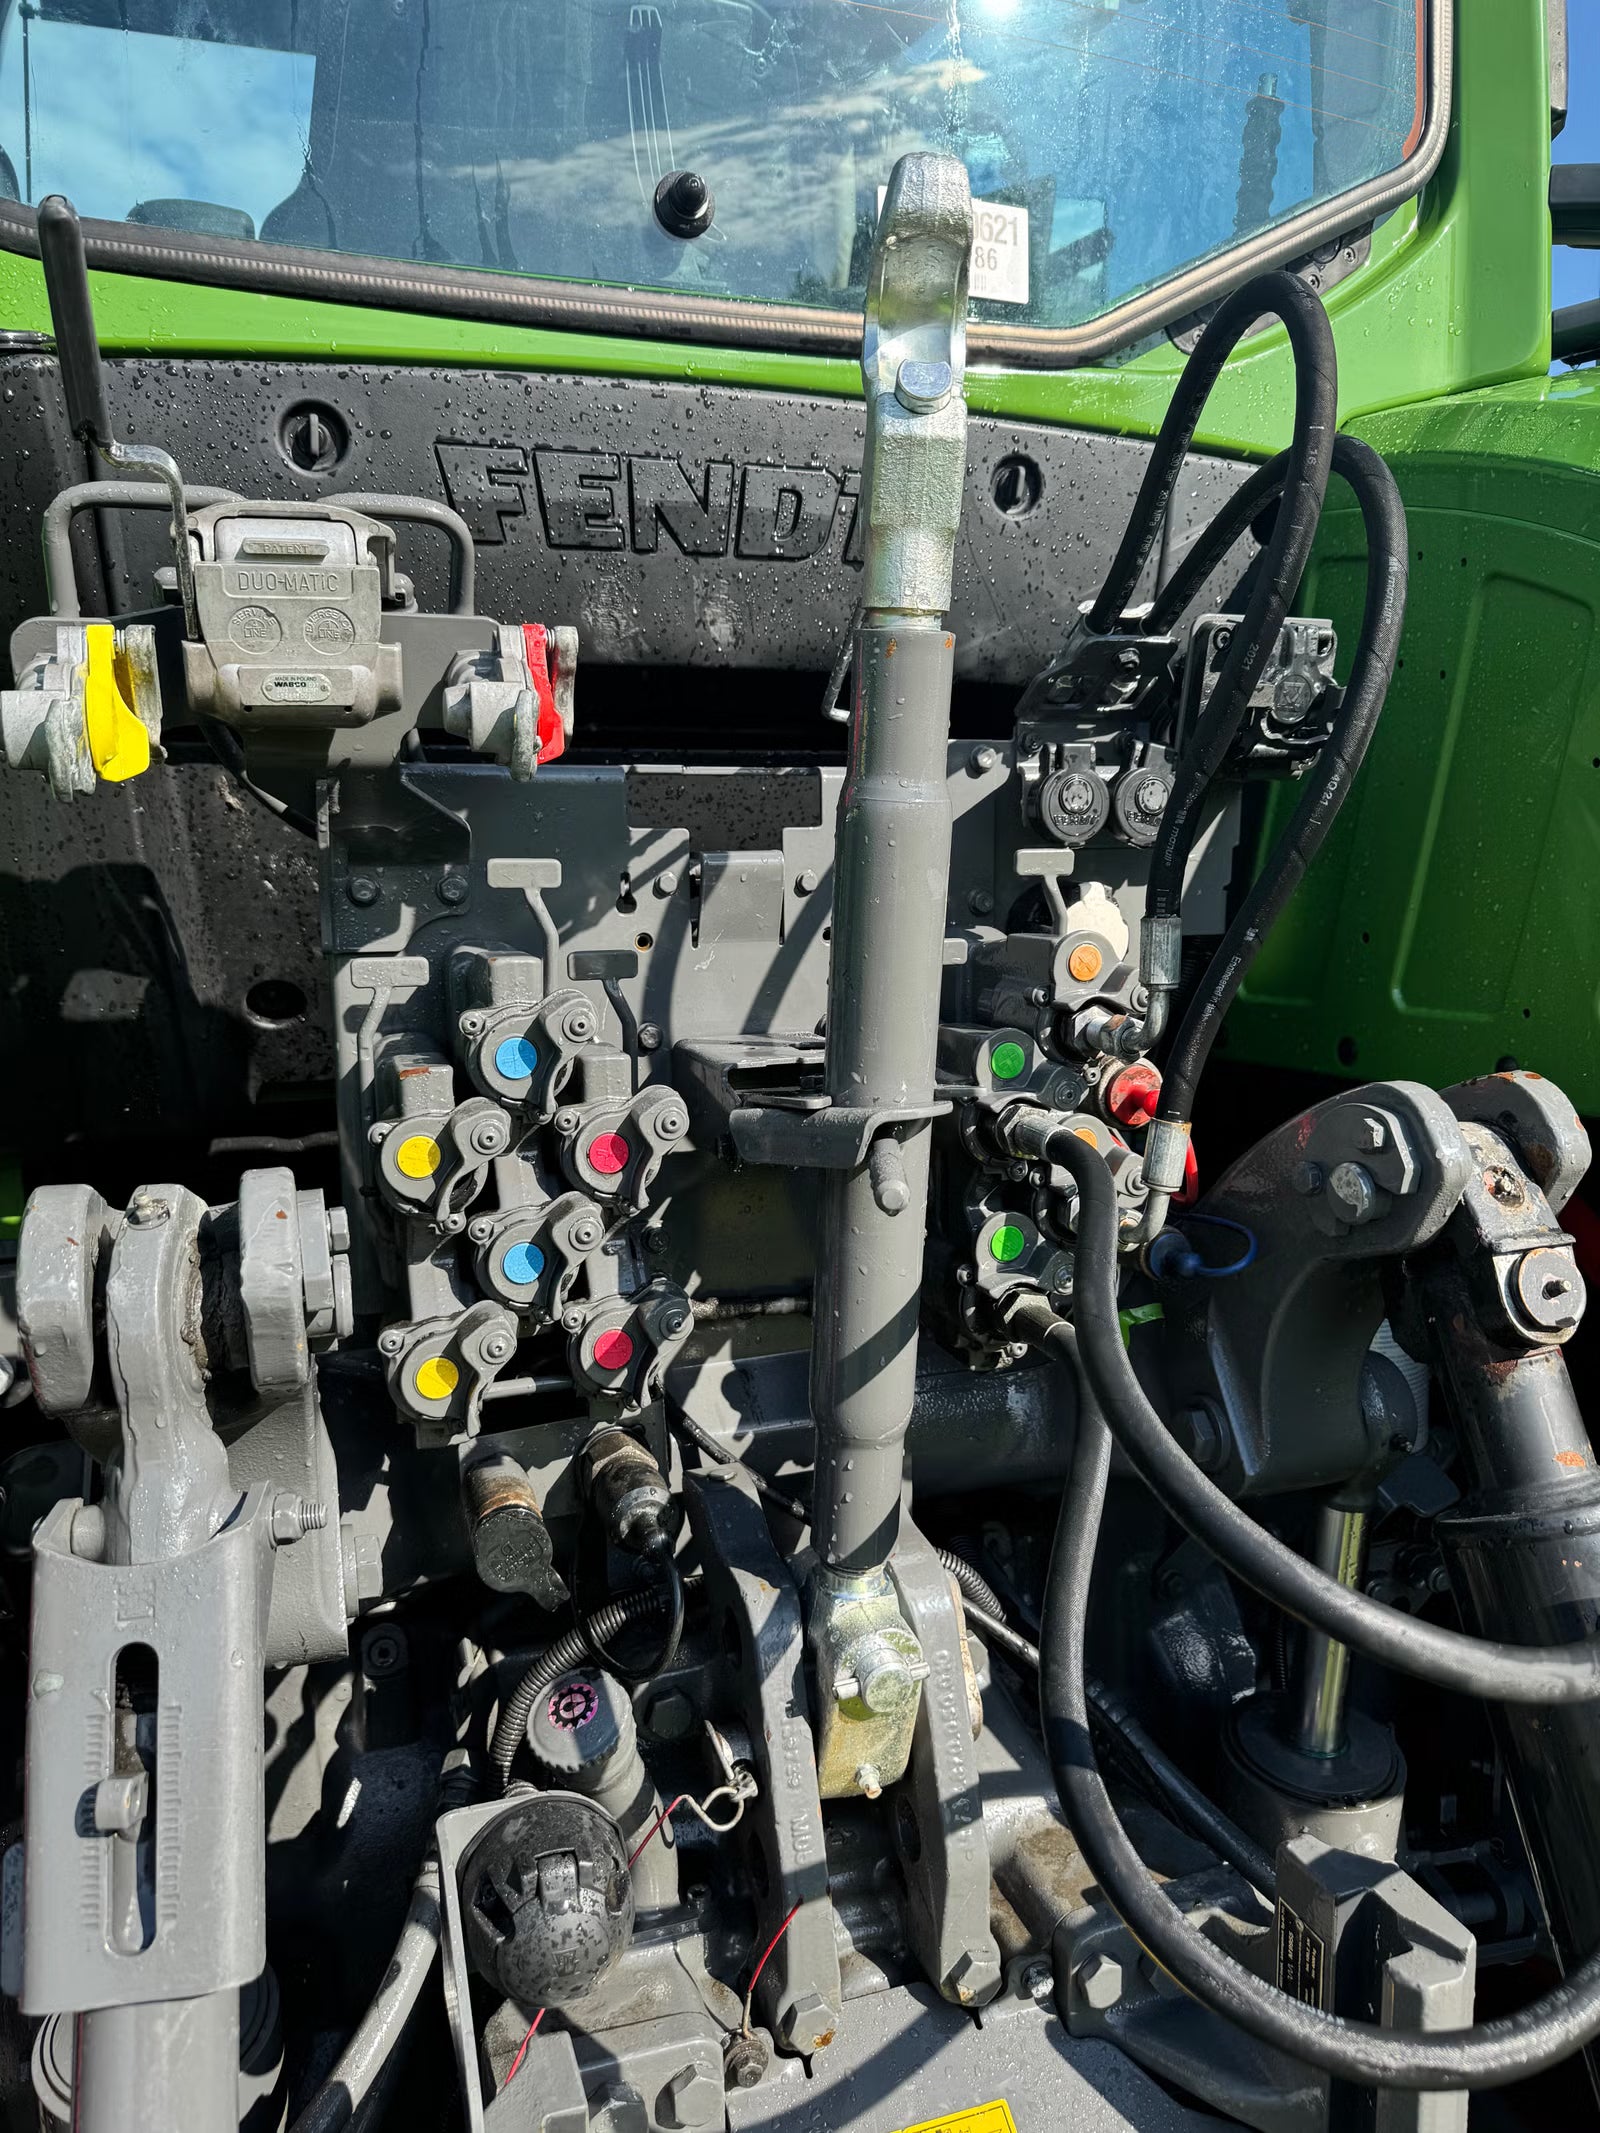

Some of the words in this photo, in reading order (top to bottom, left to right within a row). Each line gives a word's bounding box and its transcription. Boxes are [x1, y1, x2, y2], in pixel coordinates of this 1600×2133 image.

[975, 246, 998, 271] 86
[263, 543, 310, 554] PATENT
[232, 607, 277, 627] SERVCE
[243, 628, 267, 639] LINE
[318, 629, 341, 640] LINE
[1241, 642, 1260, 671] 2021
[1213, 954, 1242, 997] Engineered
